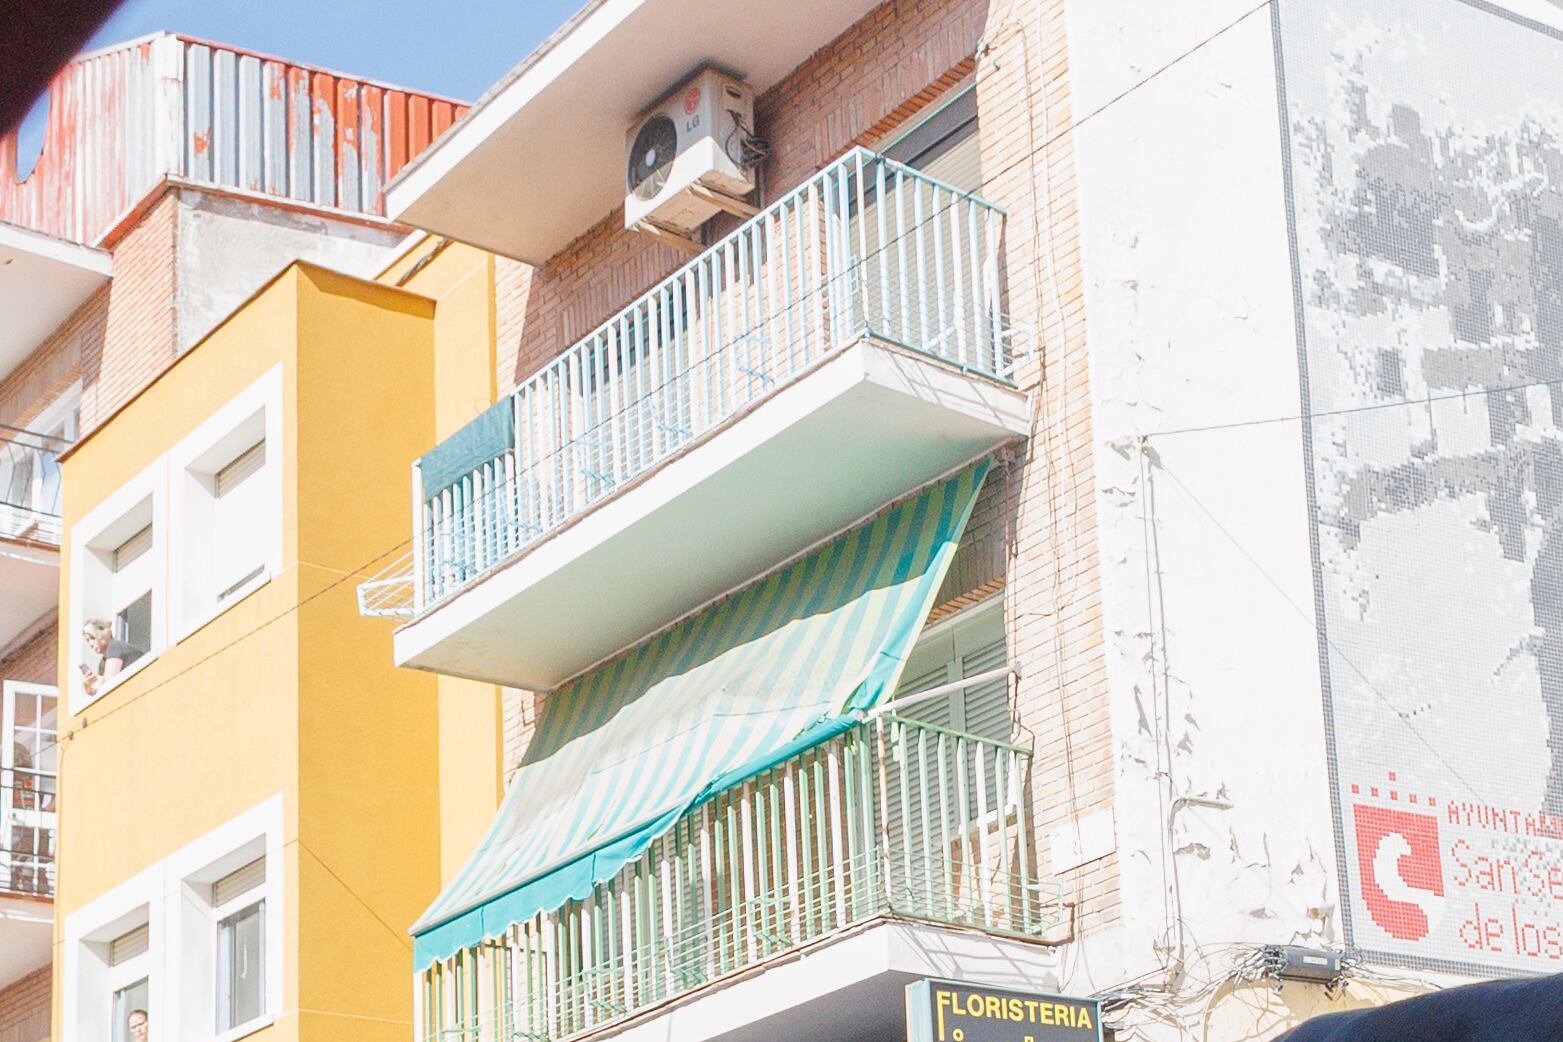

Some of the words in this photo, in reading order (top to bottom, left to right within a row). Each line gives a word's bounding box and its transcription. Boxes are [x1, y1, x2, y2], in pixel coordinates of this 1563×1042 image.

[686, 114, 700, 133] LG
[1451, 838, 1518, 895] San
[1459, 902, 1504, 952] de
[1511, 904, 1563, 960] los
[936, 990, 1093, 1042] FLORISTERIA
